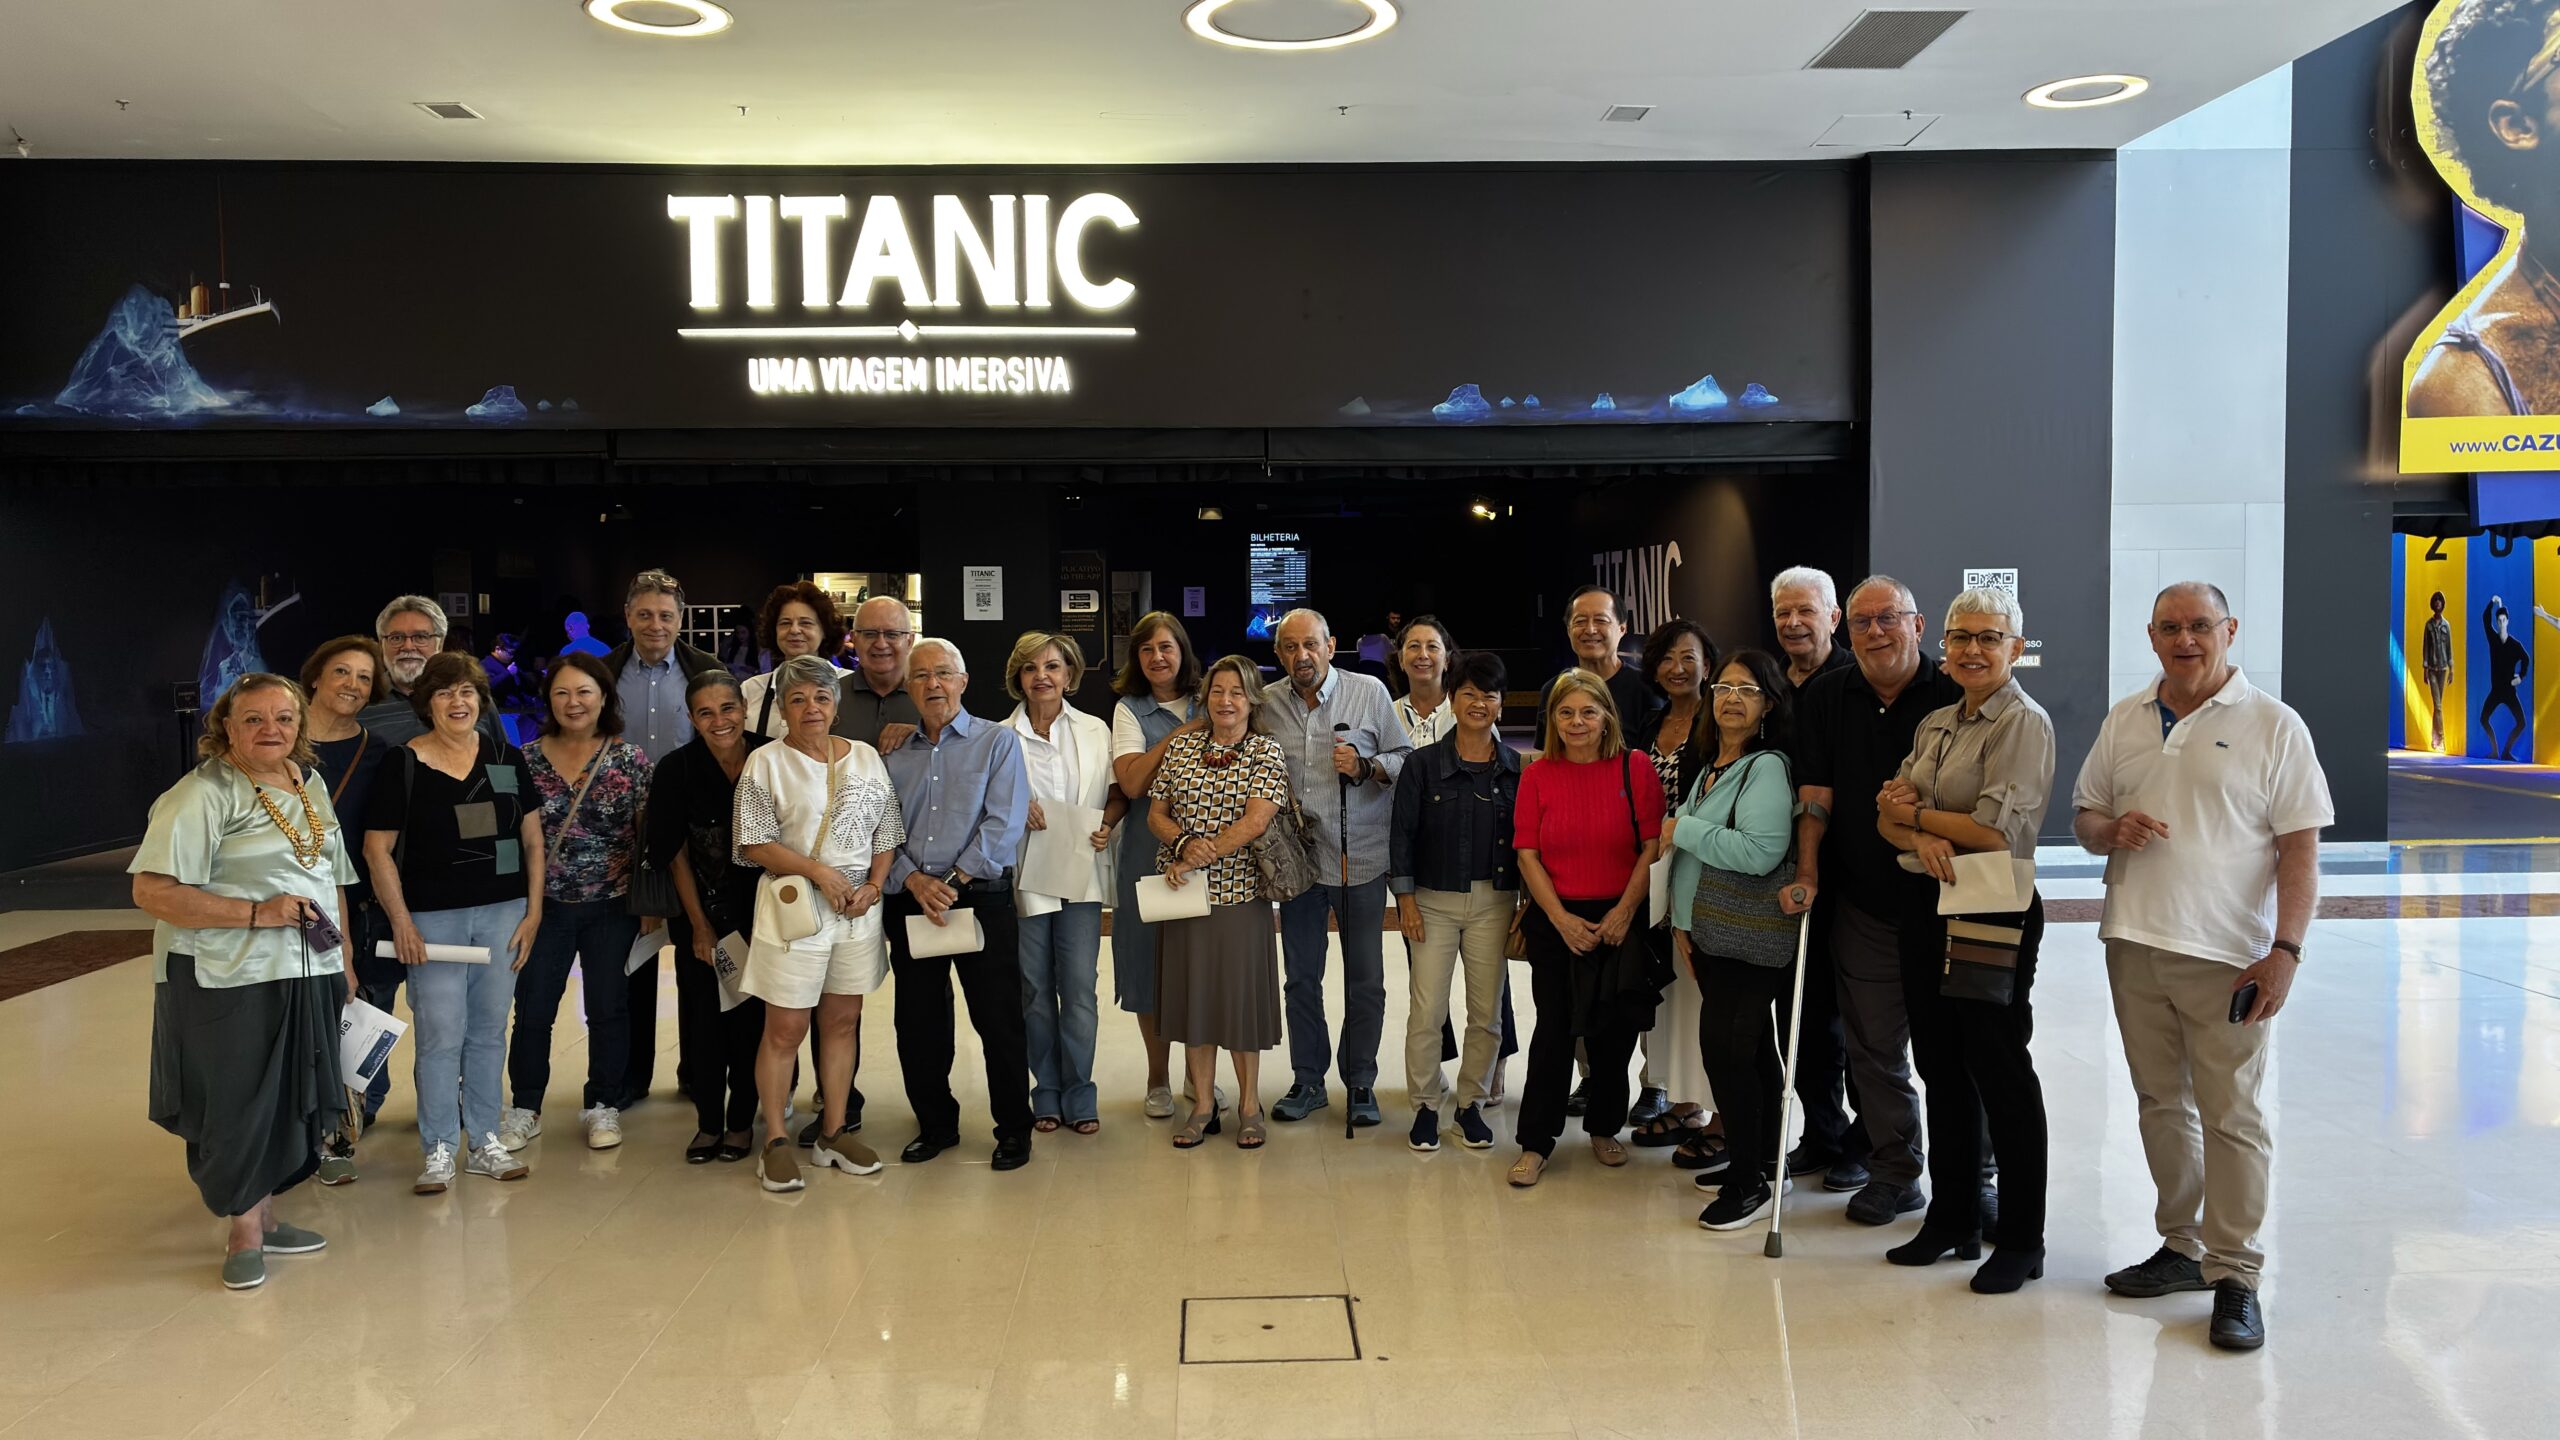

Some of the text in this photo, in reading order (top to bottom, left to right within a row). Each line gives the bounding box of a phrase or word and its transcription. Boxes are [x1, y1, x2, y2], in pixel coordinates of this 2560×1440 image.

[667, 192, 1140, 308] TITANIC
[748, 356, 1071, 393] UMA VIAGEM IMERSIVA
[2449, 434, 2560, 453] www.CAZ
[1250, 533, 1300, 541] BILHETERIA
